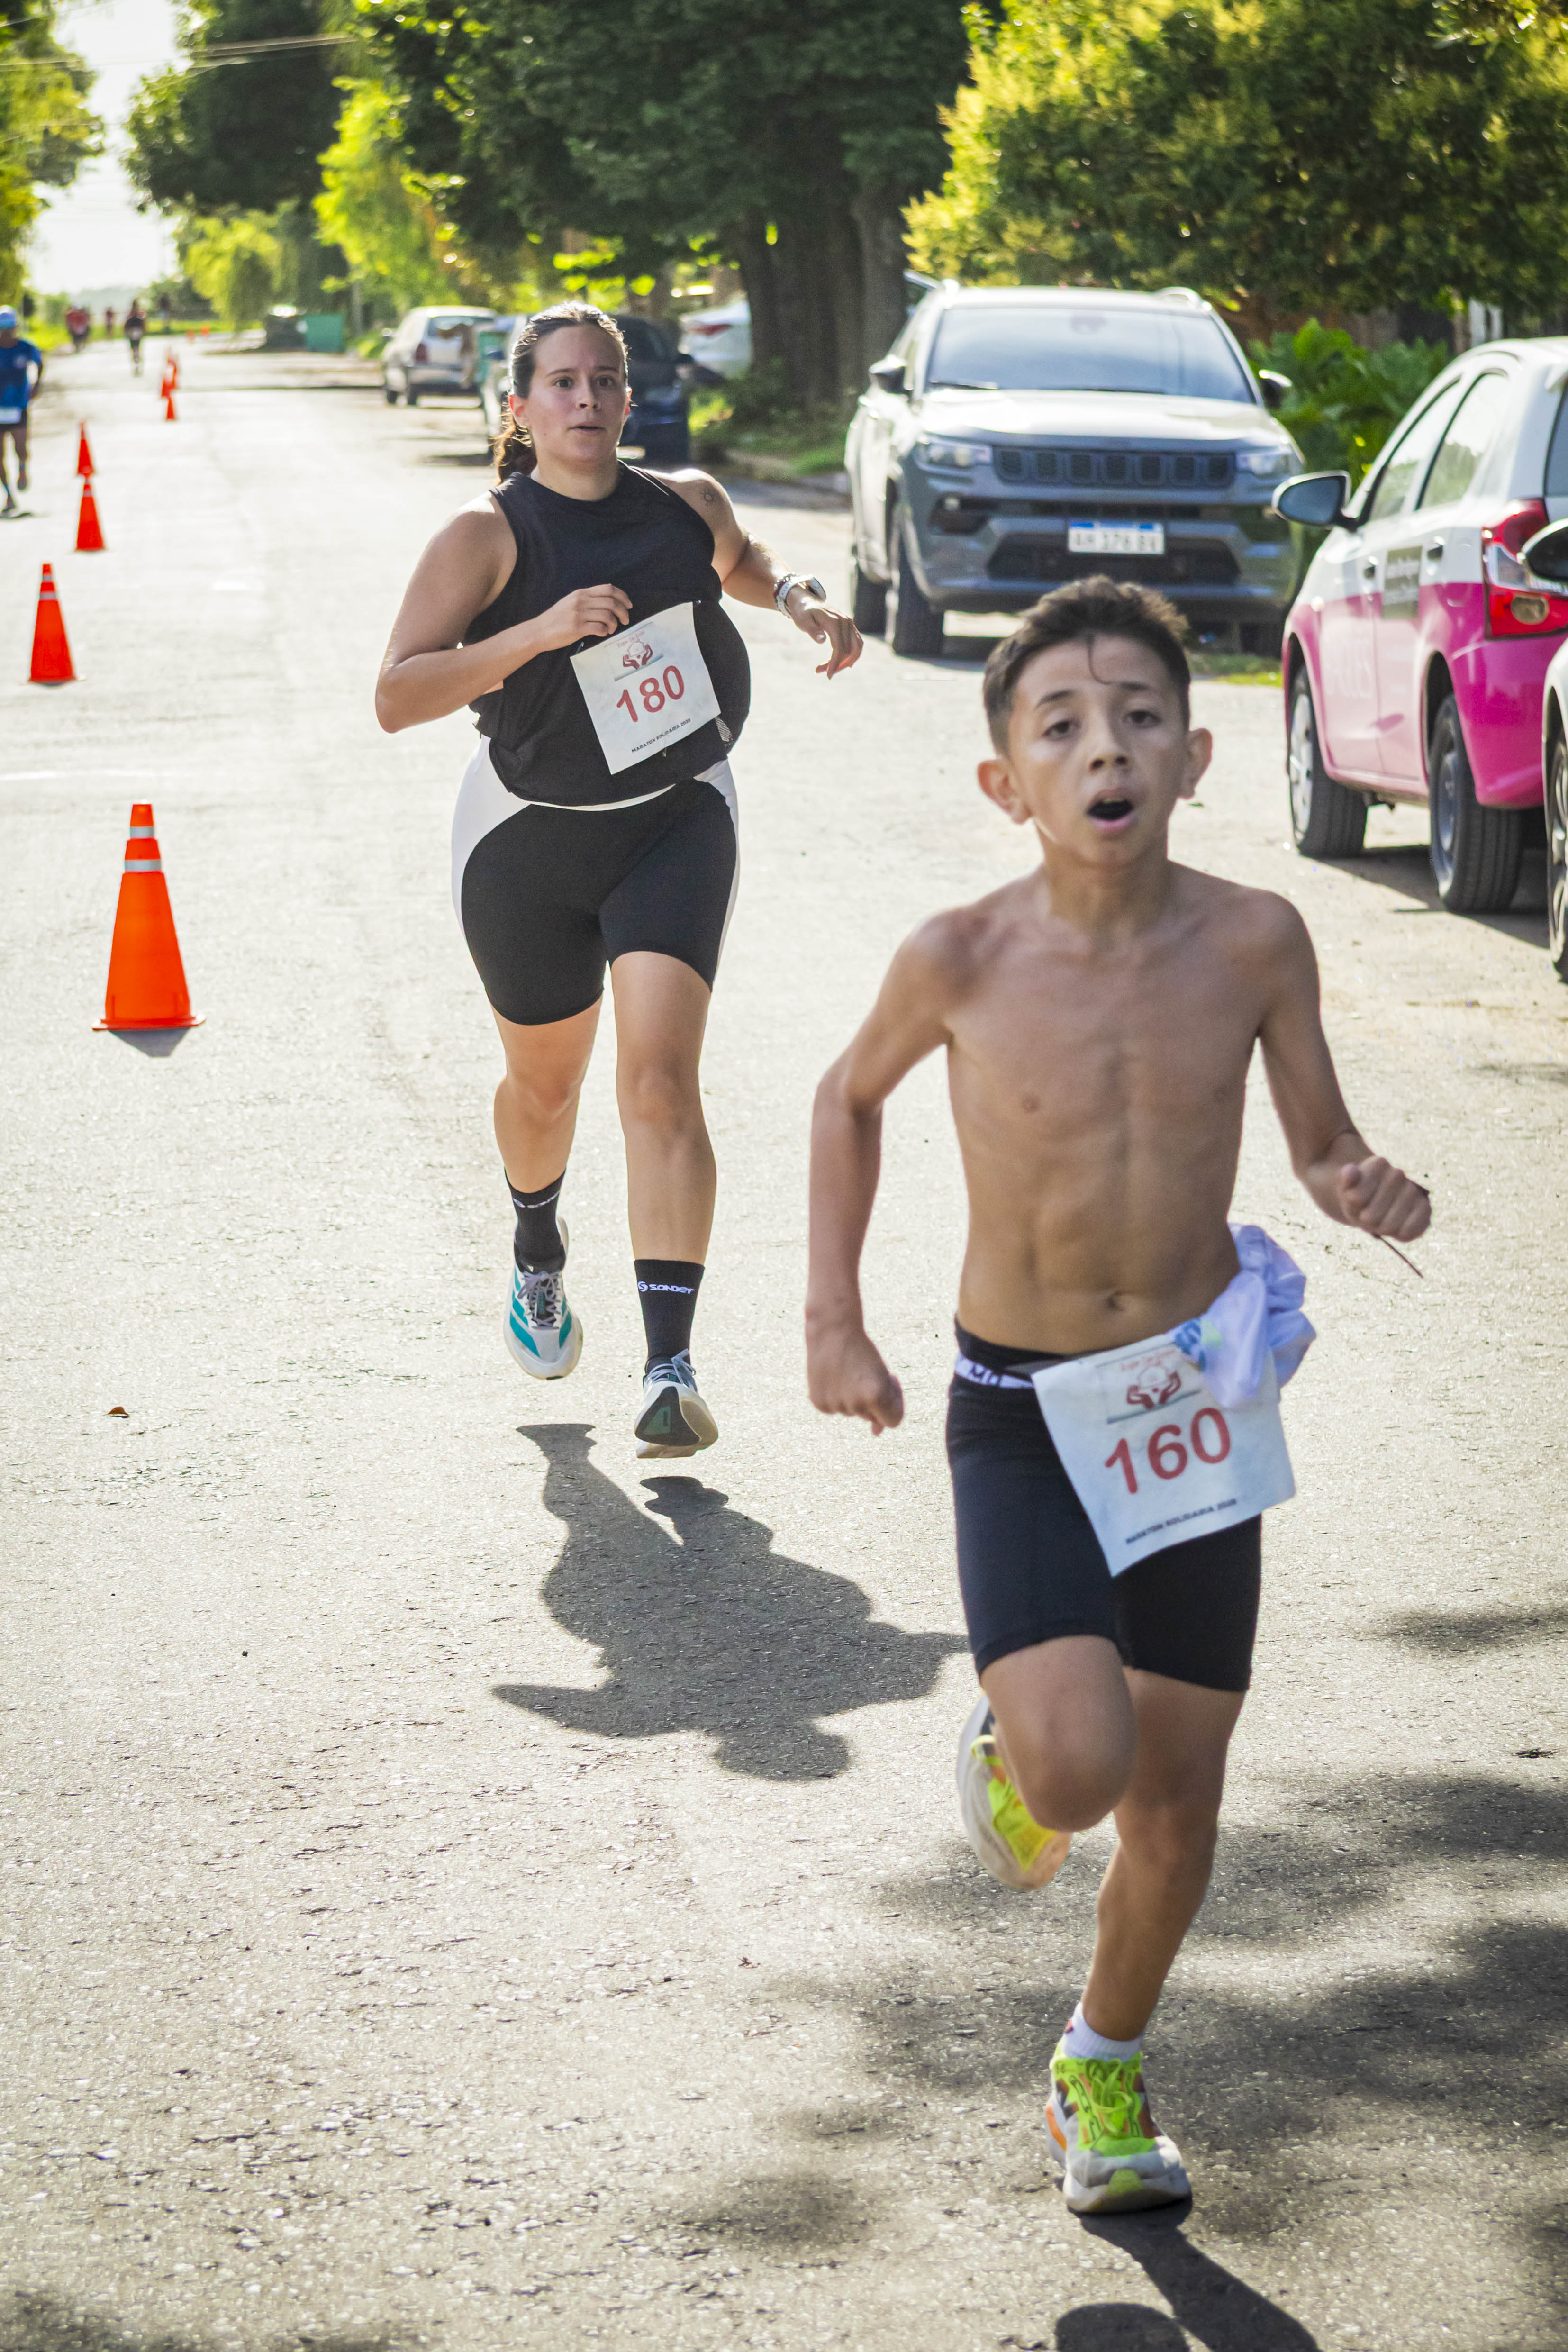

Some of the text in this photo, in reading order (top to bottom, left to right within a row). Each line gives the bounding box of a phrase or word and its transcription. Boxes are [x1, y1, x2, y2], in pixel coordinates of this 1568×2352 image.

[616, 665, 684, 722] 180
[631, 738, 655, 753] MARATON
[656, 725, 680, 740] SOLIDARIA
[1105, 1408, 1231, 1494] 160
